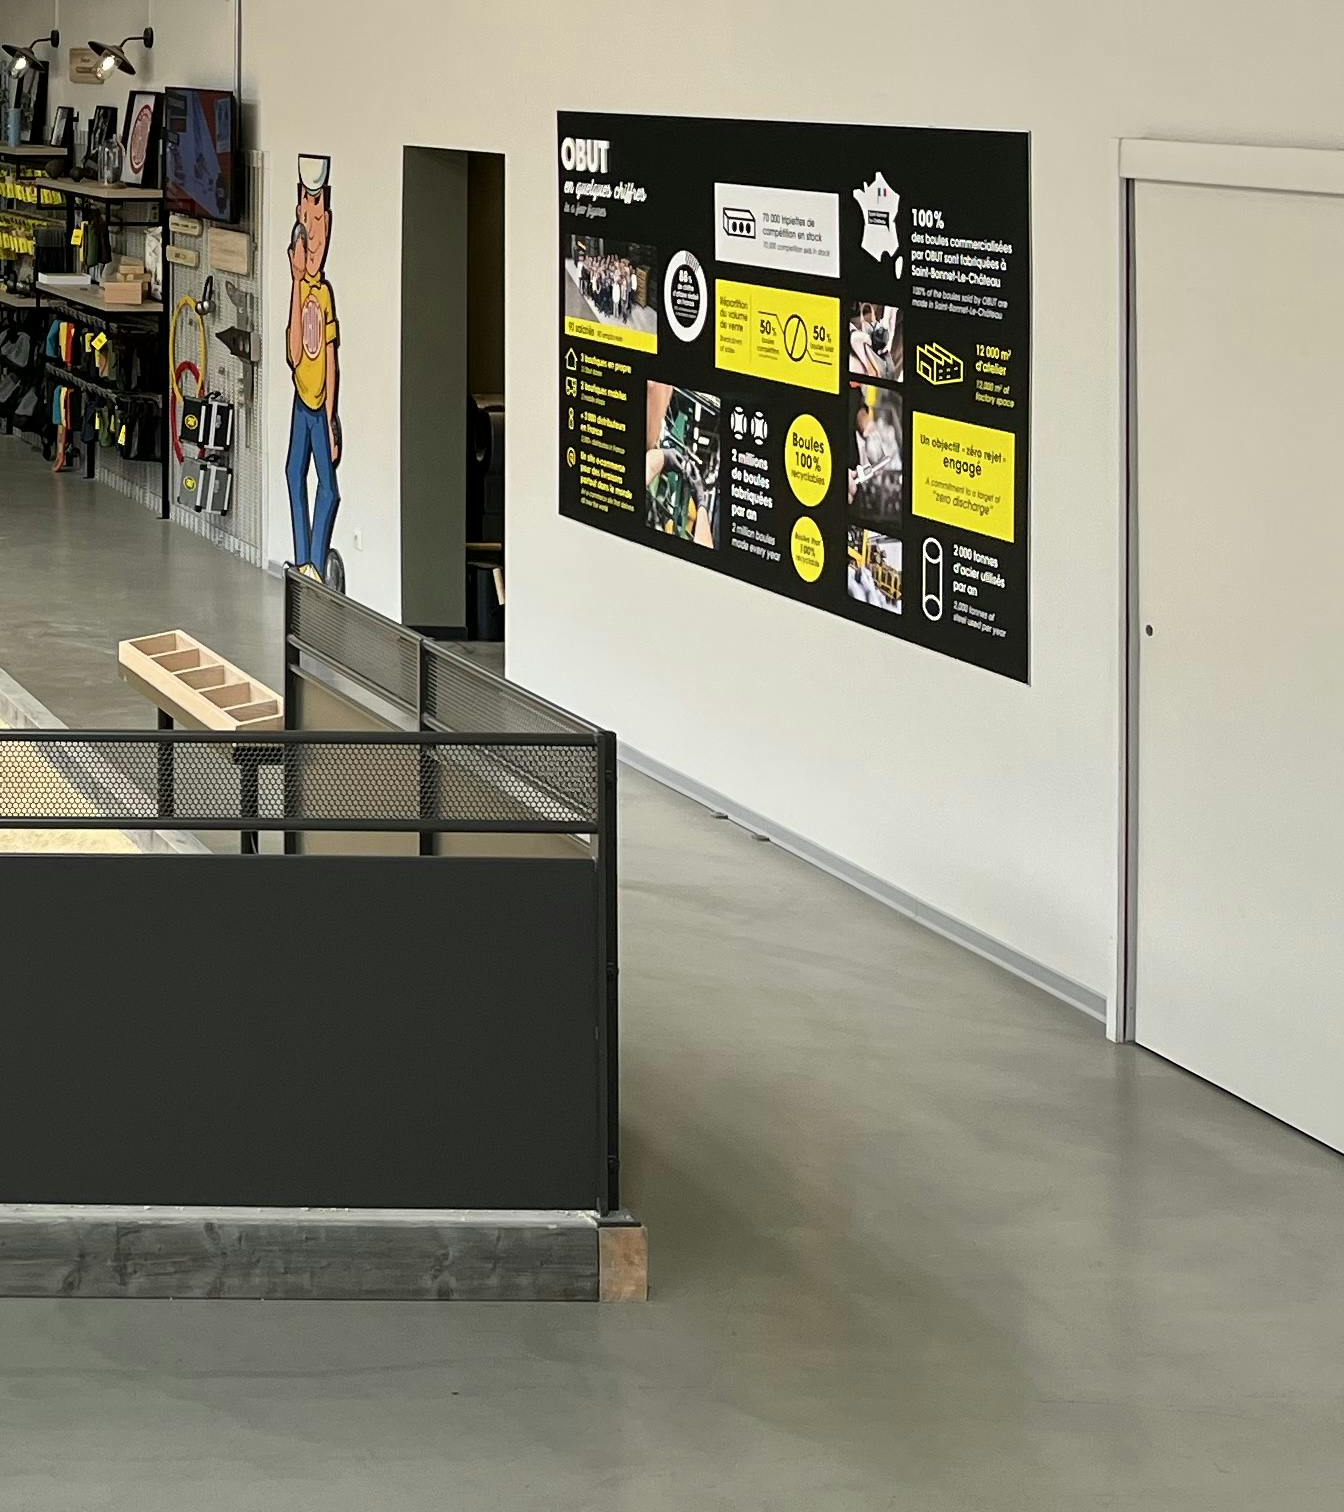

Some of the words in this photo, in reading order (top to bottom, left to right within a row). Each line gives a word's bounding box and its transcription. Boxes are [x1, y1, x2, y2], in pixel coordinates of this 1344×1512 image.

[560, 136, 610, 173] OBUT
[912, 208, 944, 229] 100%
[806, 231, 822, 242] stock
[911, 231, 924, 244] des
[925, 233, 949, 247] boules
[911, 250, 924, 262] par
[924, 249, 943, 262] OBUT
[944, 253, 959, 265] sont
[976, 344, 984, 357] 12
[985, 346, 1000, 360] 000
[792, 432, 825, 454] Boules
[920, 434, 930, 445] Un
[932, 437, 961, 453] objectif
[966, 445, 983, 458] zéro
[984, 449, 1003, 464] rejet
[731, 448, 737, 462] 2
[738, 452, 769, 471] millions
[943, 456, 982, 478] engagé
[731, 467, 742, 481] de
[743, 469, 771, 490] boules
[731, 504, 746, 518] par
[746, 509, 758, 522] an
[953, 544, 958, 557] 2
[958, 545, 972, 561] 000
[973, 549, 998, 569] tonnes
[953, 580, 966, 593] par
[967, 585, 978, 597] an
